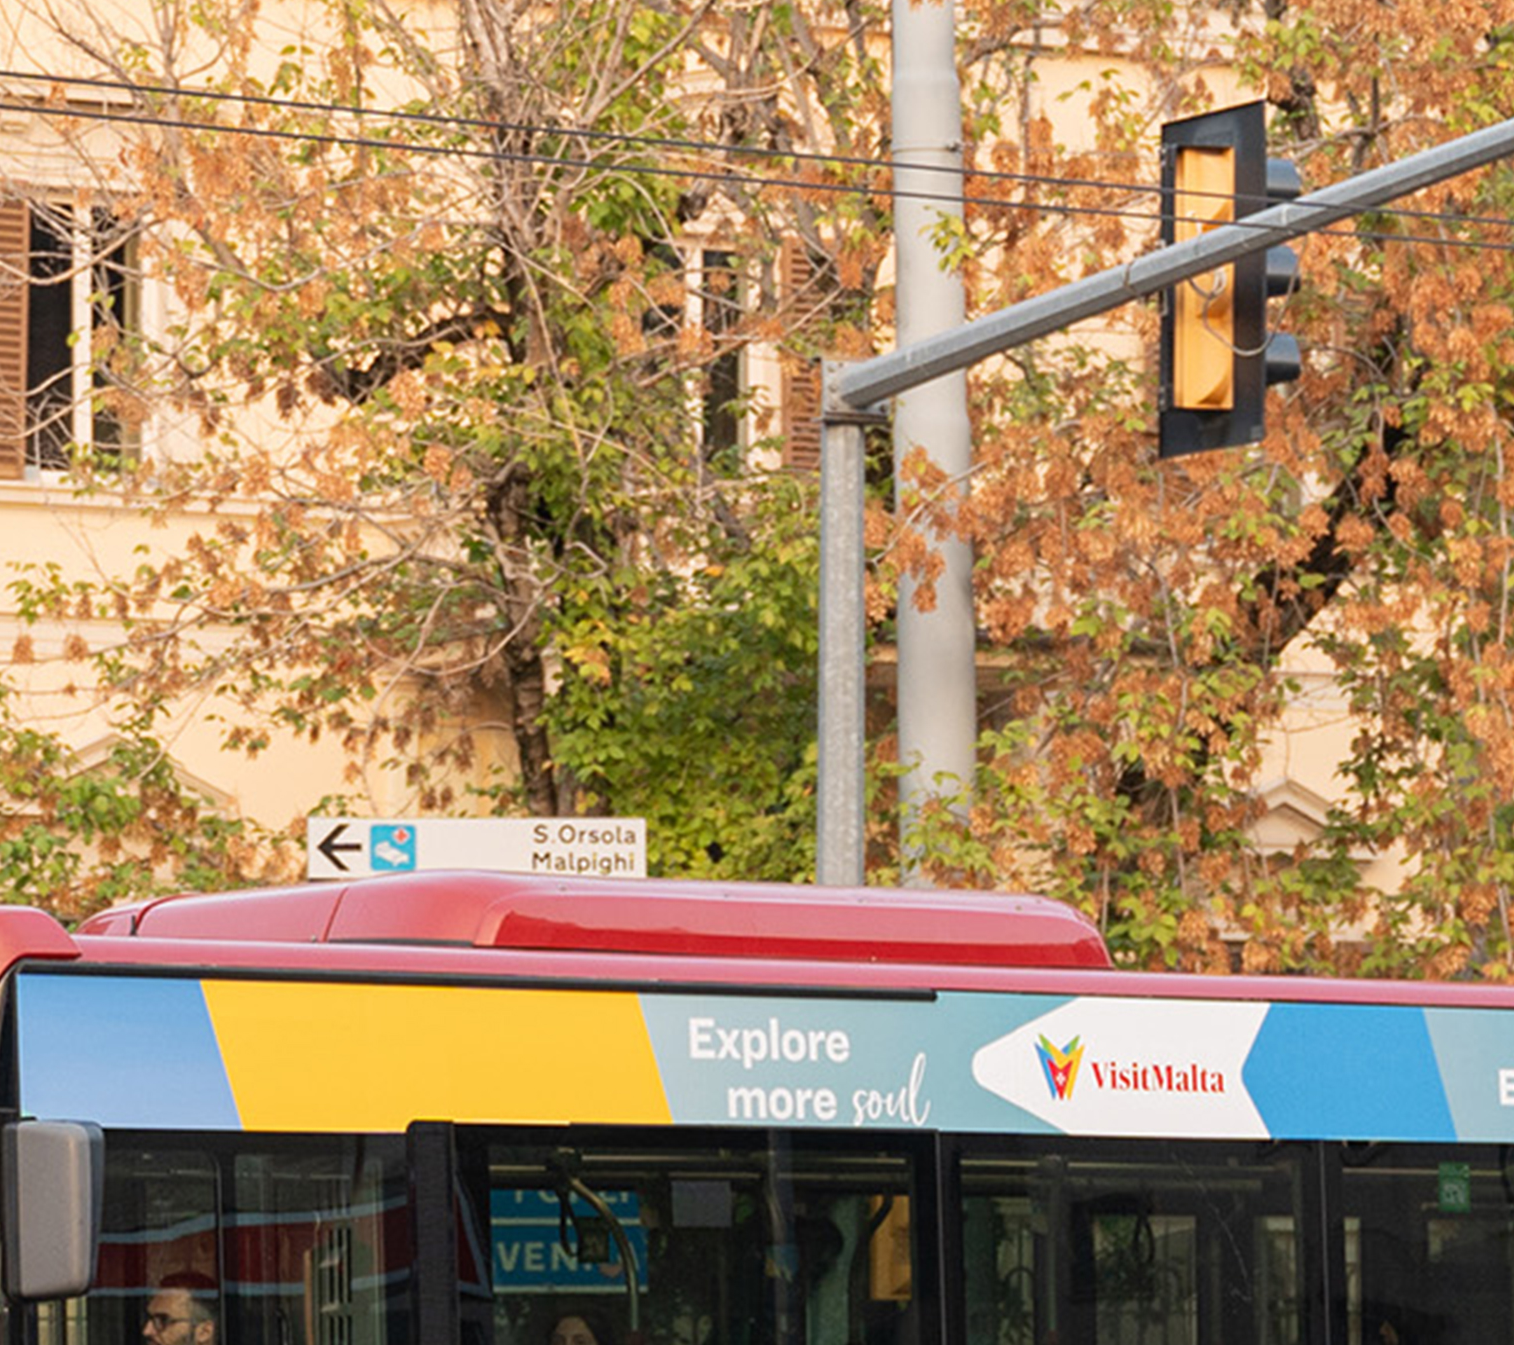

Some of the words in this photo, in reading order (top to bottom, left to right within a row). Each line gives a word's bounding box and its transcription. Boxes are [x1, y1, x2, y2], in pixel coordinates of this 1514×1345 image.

[532, 851, 635, 875] Malpighi
[689, 1018, 850, 1069] Explore
[728, 1087, 837, 1120] more
[853, 1052, 932, 1127] soul
[1090, 1060, 1225, 1094] VisitMalta
